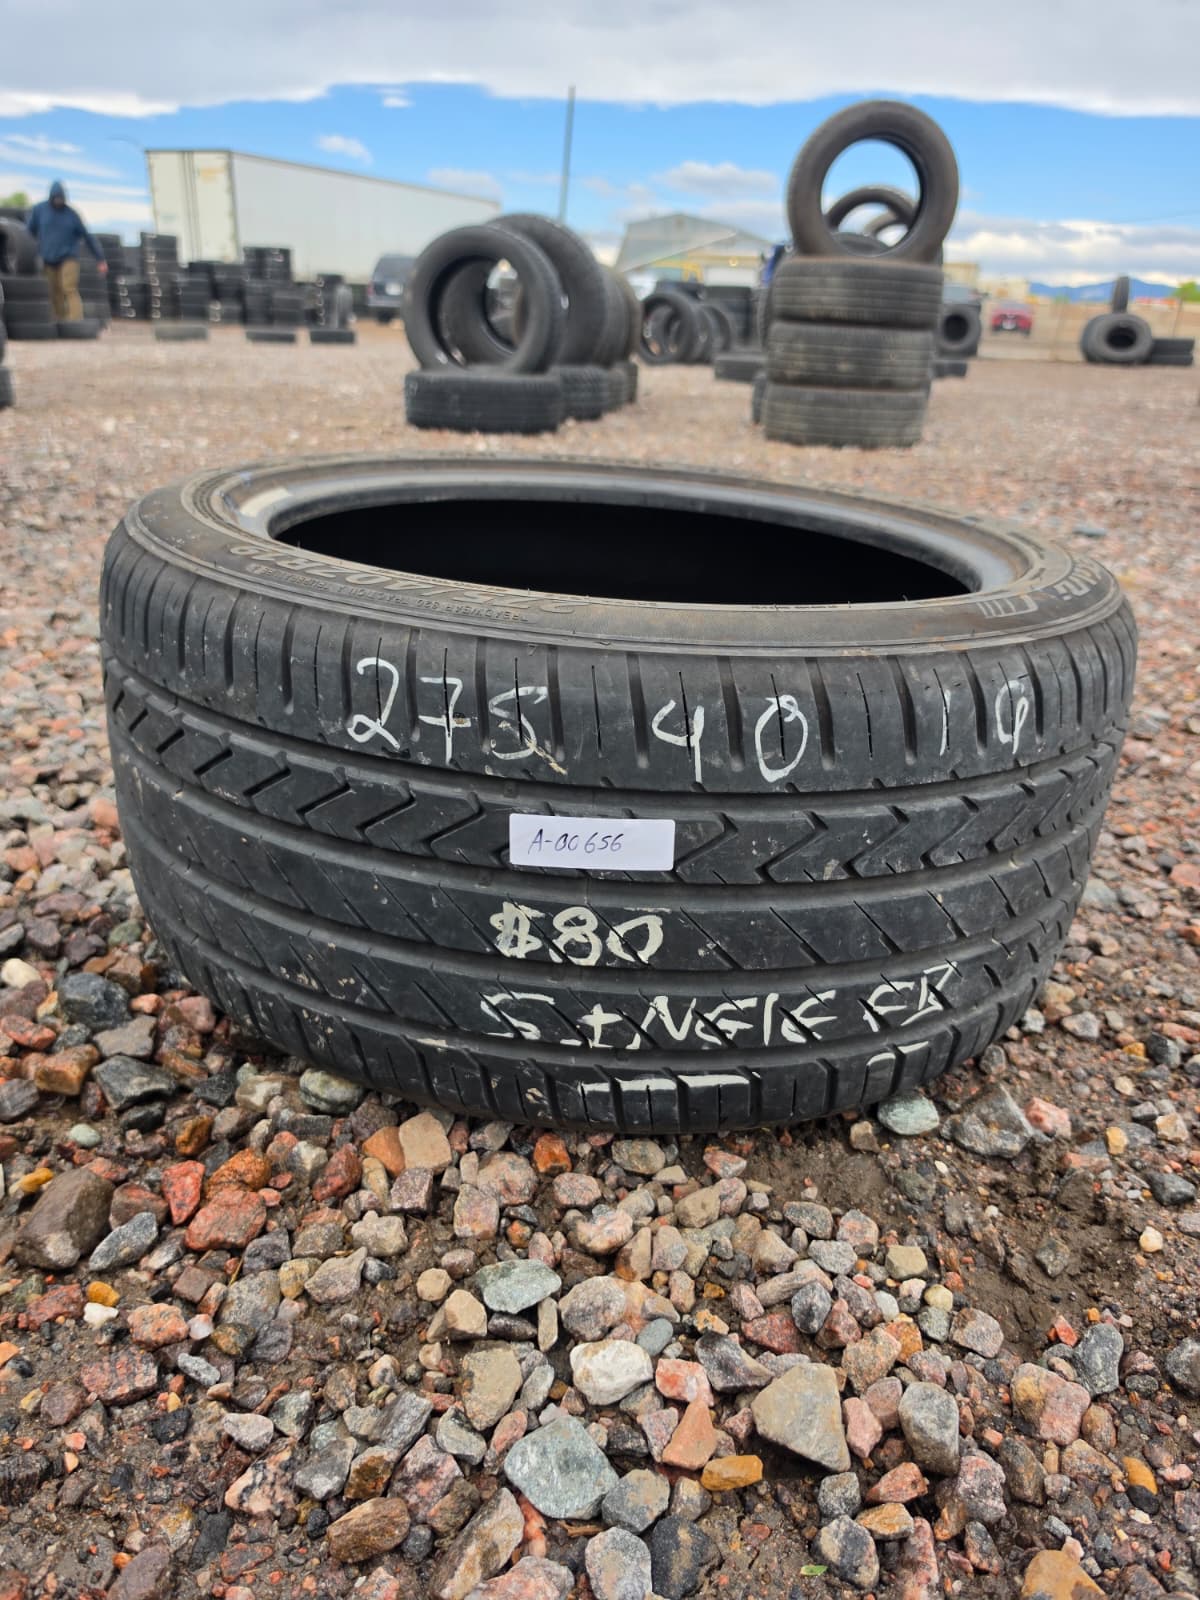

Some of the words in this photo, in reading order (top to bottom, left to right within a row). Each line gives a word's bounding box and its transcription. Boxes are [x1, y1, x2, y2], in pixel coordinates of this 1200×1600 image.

[347, 656, 549, 765] 275
[651, 694, 808, 784] 40
[489, 901, 664, 967] $80
